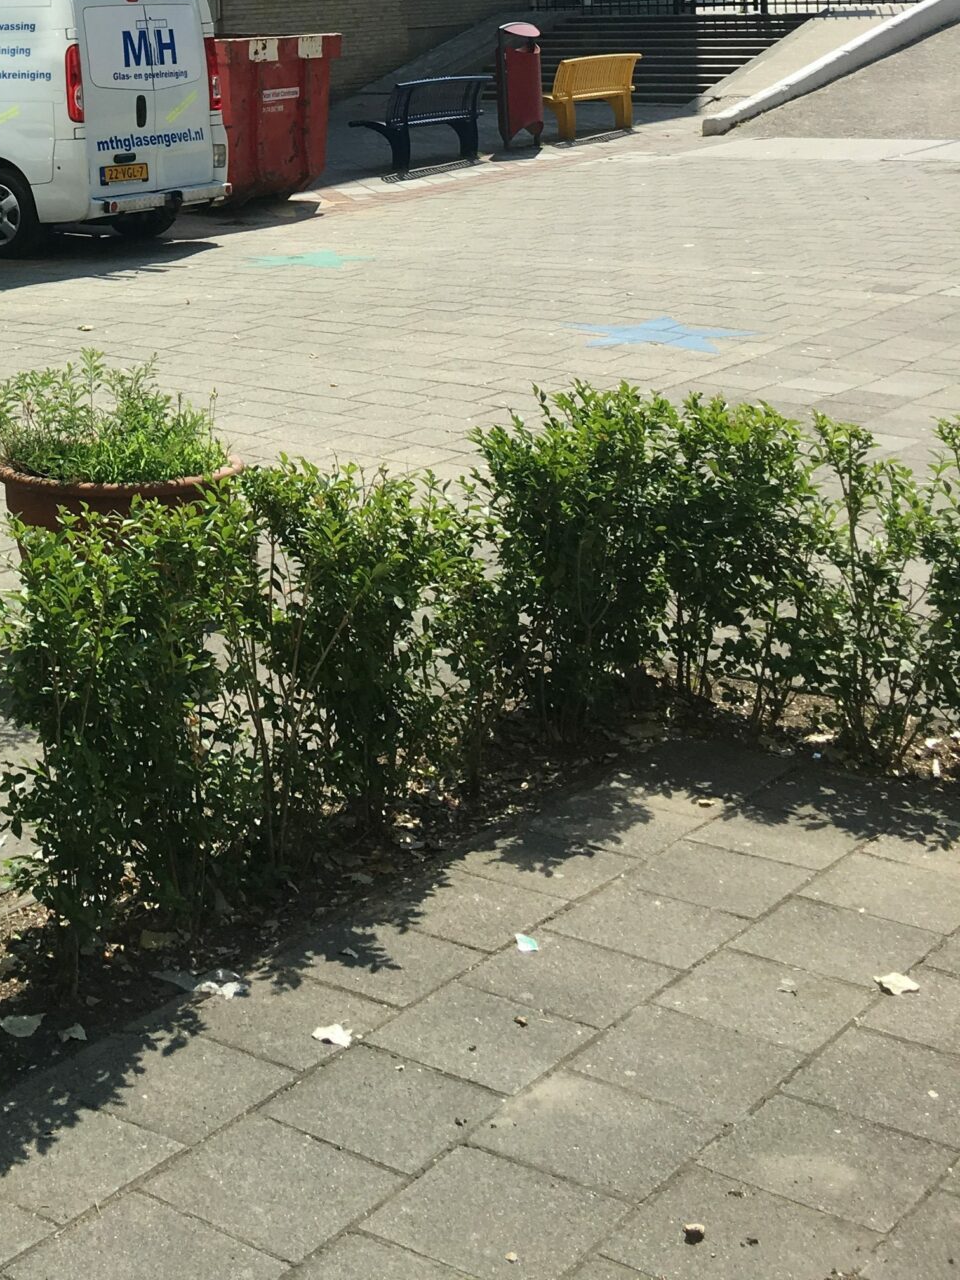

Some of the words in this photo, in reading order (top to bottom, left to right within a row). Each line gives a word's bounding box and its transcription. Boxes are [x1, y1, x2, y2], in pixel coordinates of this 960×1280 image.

[112, 72, 132, 80] Glas-
[144, 69, 188, 81] gevelreiniging
[97, 127, 204, 152] mthglasengevel.nl
[108, 166, 145, 180] 22-VGL-7
